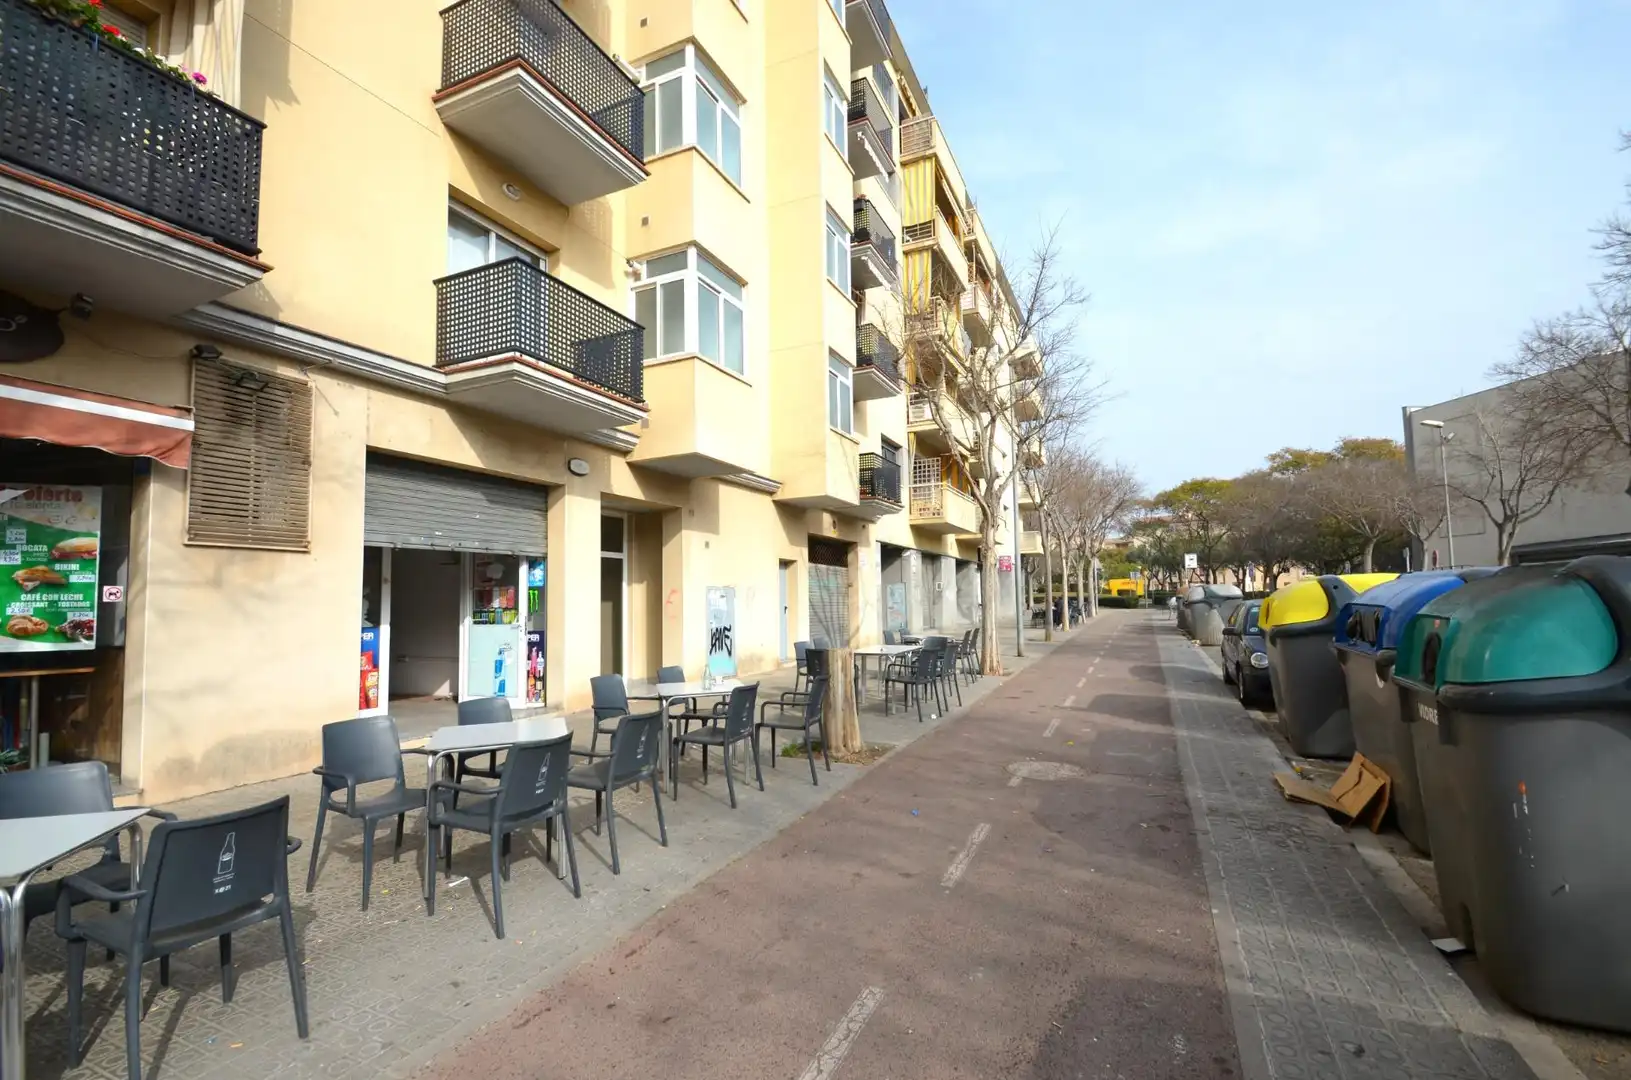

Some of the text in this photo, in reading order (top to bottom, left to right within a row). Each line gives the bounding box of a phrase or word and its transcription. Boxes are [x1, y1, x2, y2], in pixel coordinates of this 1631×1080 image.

[54, 563, 80, 571] BIKINI
[20, 592, 41, 601] CAFÉ
[60, 593, 84, 601] LECHE
